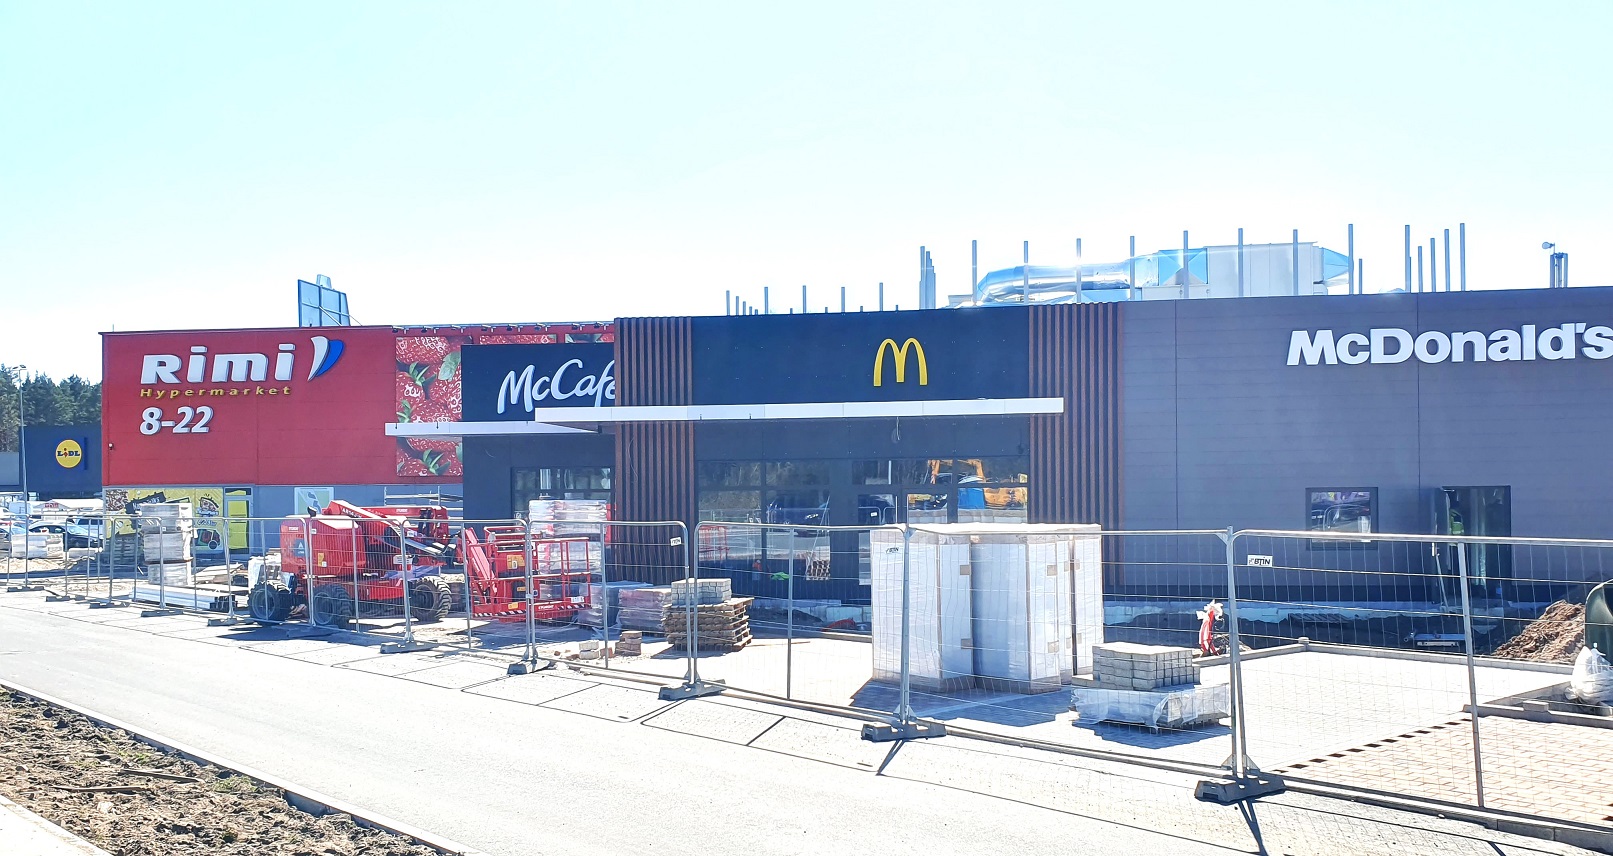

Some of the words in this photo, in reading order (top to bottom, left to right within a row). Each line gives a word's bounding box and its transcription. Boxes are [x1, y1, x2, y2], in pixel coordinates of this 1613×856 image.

[1286, 322, 1613, 366] McDonald's
[140, 343, 297, 384] Rimi
[140, 386, 292, 399] Hypermarket
[139, 405, 214, 436] 8-22
